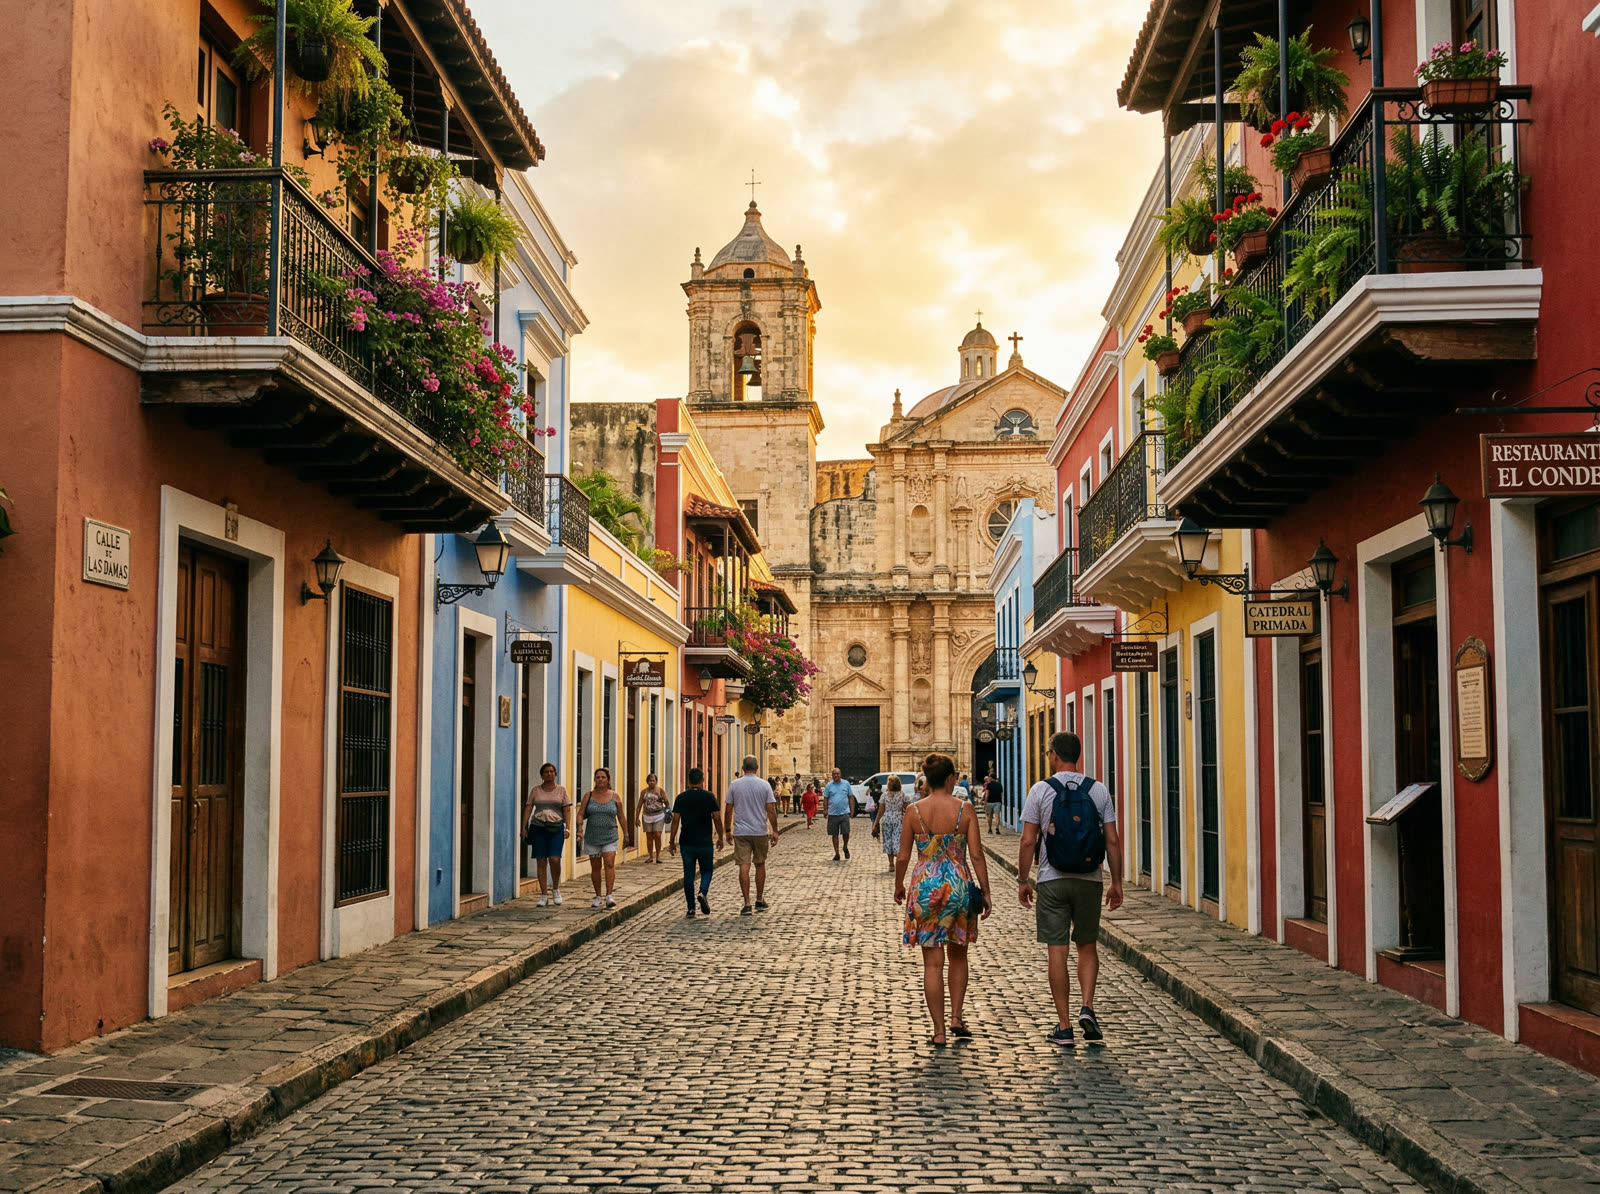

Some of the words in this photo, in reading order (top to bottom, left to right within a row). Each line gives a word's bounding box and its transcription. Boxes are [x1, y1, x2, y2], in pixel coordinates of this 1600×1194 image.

[1491, 444, 1600, 462] RESTAURANT
[1497, 467, 1523, 487] EL
[1528, 466, 1600, 486] CONDE
[96, 530, 120, 551] CALLE
[88, 555, 103, 573] LAS
[104, 560, 128, 580] DAMAS
[1248, 606, 1312, 618] CATEDRAL
[1253, 619, 1307, 631] PRIMADA
